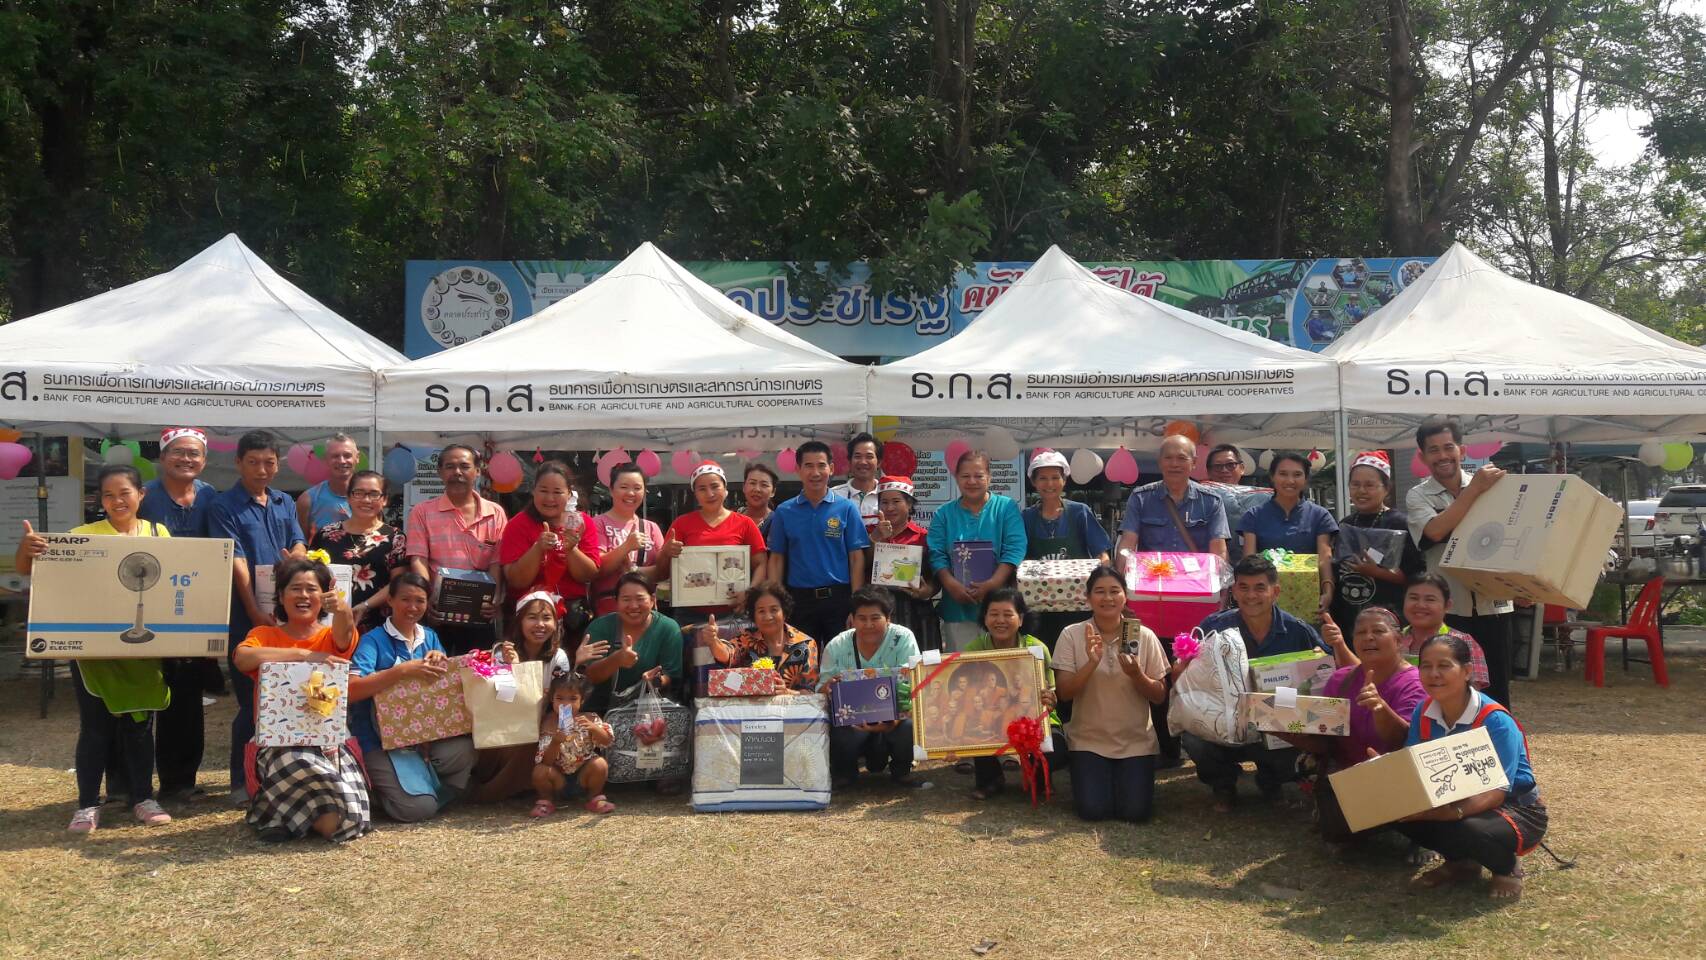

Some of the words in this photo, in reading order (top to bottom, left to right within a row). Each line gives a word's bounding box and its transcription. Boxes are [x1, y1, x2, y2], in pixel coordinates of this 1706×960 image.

[1027, 368, 1295, 384] ธนาคารเพือการเกษตรและสหกรณการเกษตร
[1386, 368, 1500, 397] ธ.ก.ส.
[911, 372, 1023, 400] ธ.ก.ส.
[1026, 391, 1049, 399] BANK
[1053, 391, 1071, 399] FOR
[1074, 391, 1134, 399] AGRICULTURE
[1137, 390, 1156, 398] AND
[1158, 389, 1224, 398] AGRICULTURAL
[1227, 386, 1295, 396] COOPERATIVES
[1503, 388, 1527, 396] BANK
[1530, 388, 1548, 397] FOR
[1552, 388, 1609, 397] AGRICULTURE
[1613, 388, 1630, 397] AND
[1633, 388, 1695, 397] AGRICULTURAL
[43, 394, 68, 402] BANK
[73, 395, 92, 403] FOR
[96, 395, 159, 405] AGRICULTURE
[162, 398, 181, 406] AND
[183, 398, 253, 408] AGRICULTURAL
[256, 400, 326, 408] COOPERATIVES
[425, 383, 545, 413] ธ.ก.ส.
[549, 403, 574, 411] BANK
[578, 402, 597, 411] FOR
[601, 401, 662, 410] AGRICULTURE
[666, 401, 685, 409] AND
[687, 400, 754, 409] AGRICULTURAL
[757, 398, 824, 407] COOPERATIVES
[1263, 674, 1290, 684] PHILIPS
